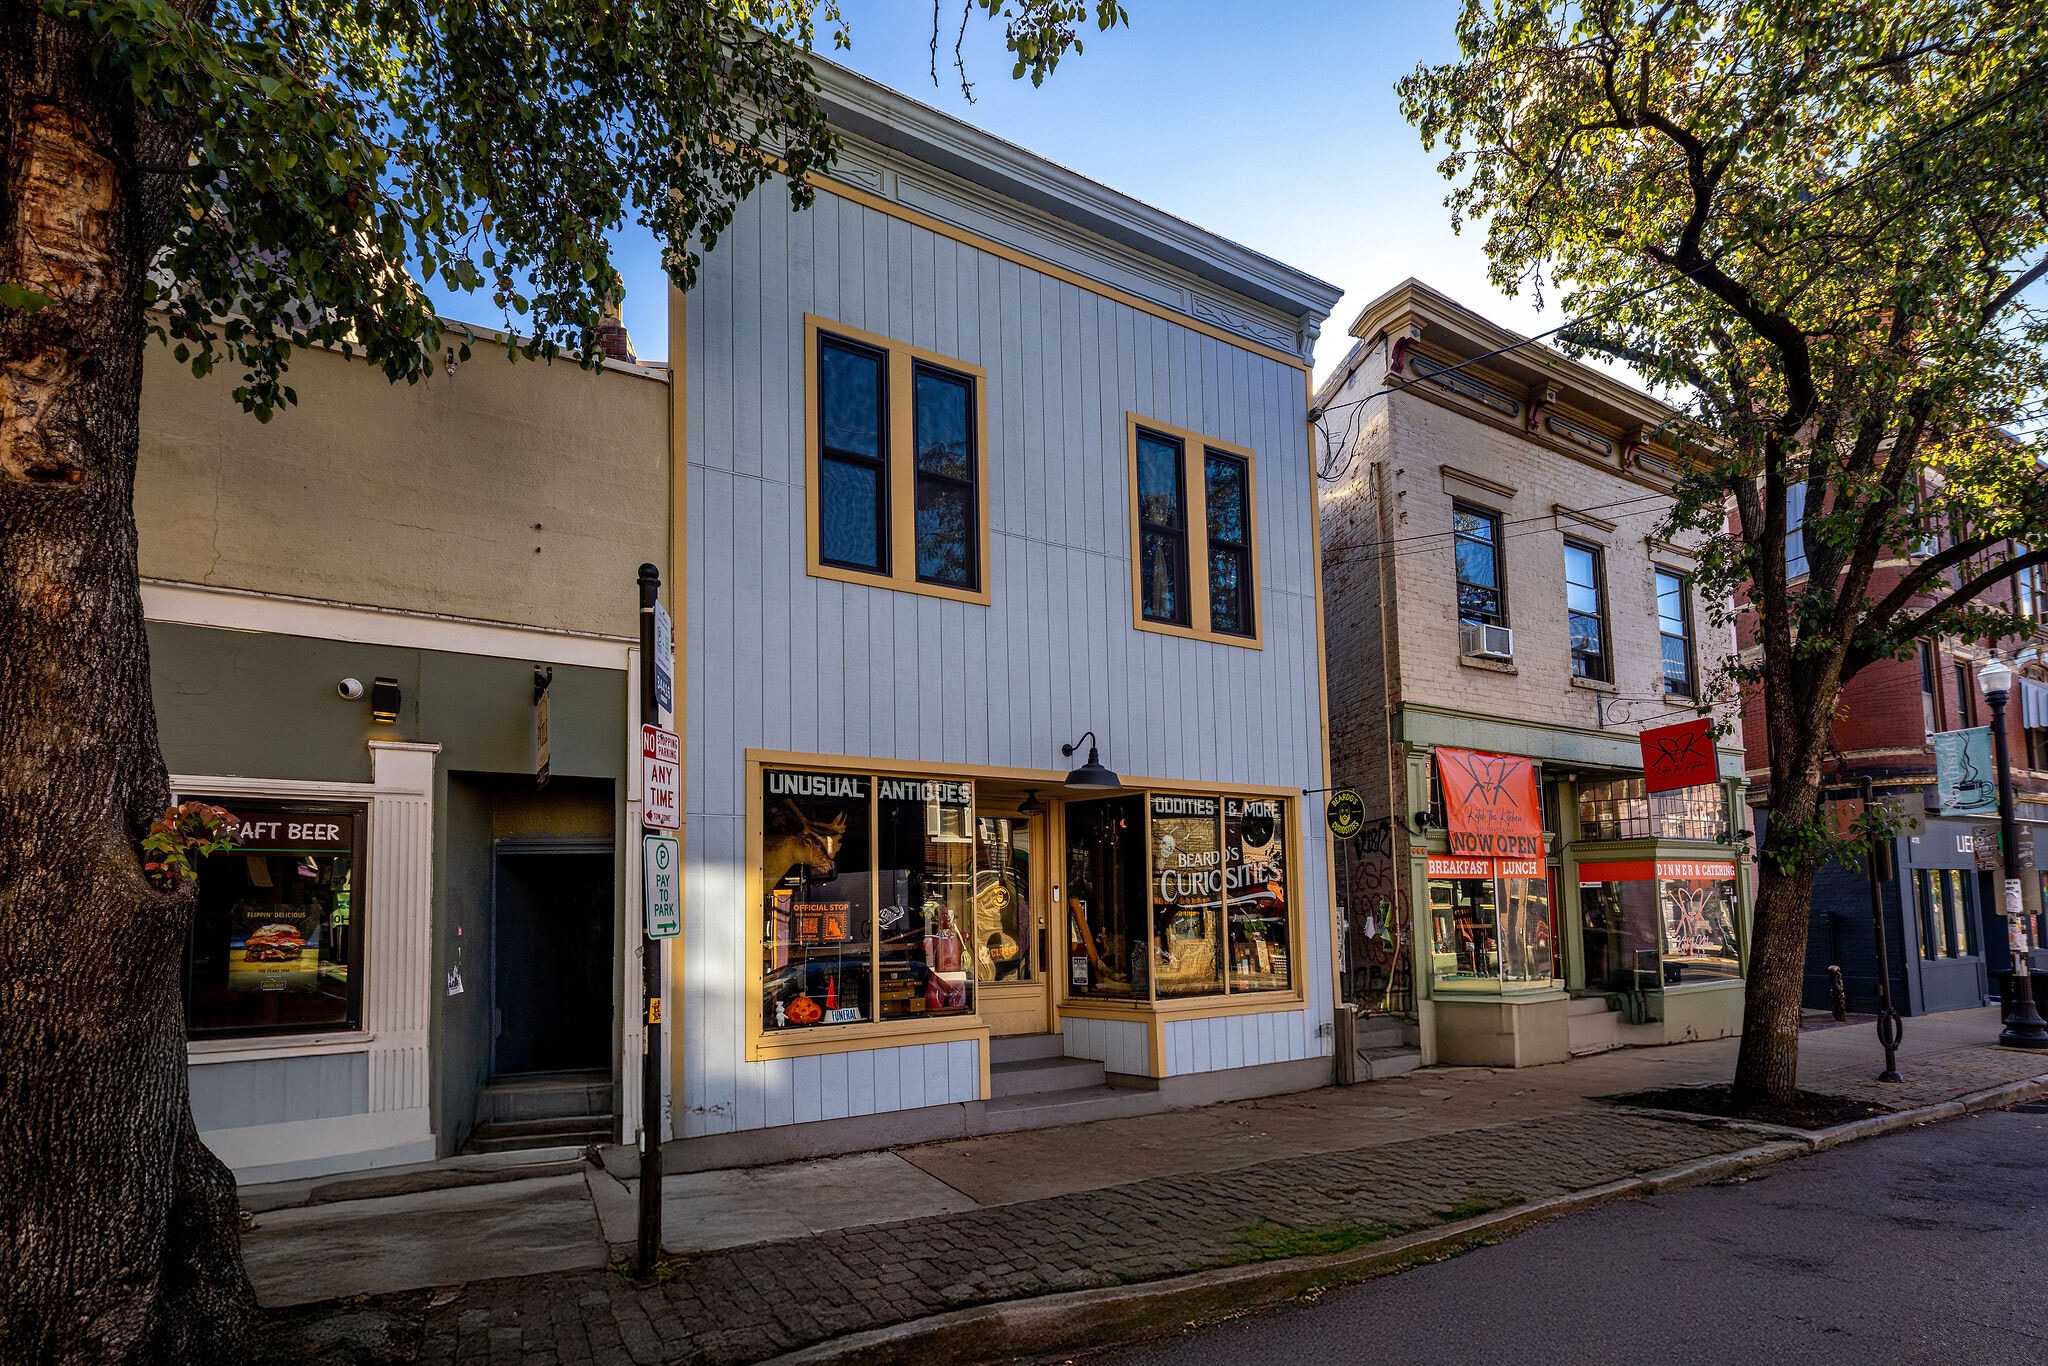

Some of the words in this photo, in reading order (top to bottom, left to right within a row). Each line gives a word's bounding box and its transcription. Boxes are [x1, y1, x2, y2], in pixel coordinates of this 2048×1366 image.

[643, 732, 655, 753] NO
[658, 746, 677, 760] PARKING
[651, 763, 673, 785] ANY
[769, 773, 865, 799] UNUSUAL
[879, 780, 972, 804] ANTIQUES
[650, 787, 674, 809] TIME
[1331, 793, 1359, 807] BEARDO'S
[1155, 797, 1215, 815] ODDITIES
[1228, 800, 1238, 817] &
[1244, 800, 1281, 818] MORE
[653, 812, 662, 820] TOW
[288, 823, 340, 841] BEER
[1453, 831, 1494, 853] NOW
[1496, 833, 1537, 855] OPEN
[1428, 860, 1489, 875] BREAKFAST
[1502, 861, 1538, 875] LUNCH
[1657, 864, 1694, 876] DINNER
[1695, 864, 1700, 876] &
[1701, 864, 1736, 876] CATERING
[656, 874, 671, 888] PAY
[1160, 861, 1283, 902] CURIOSITIES
[659, 888, 669, 902] TO
[654, 903, 675, 917] PARK
[793, 904, 828, 912] OFFICIAL
[829, 903, 849, 911] STOP
[831, 1009, 857, 1021] FUNERAL
